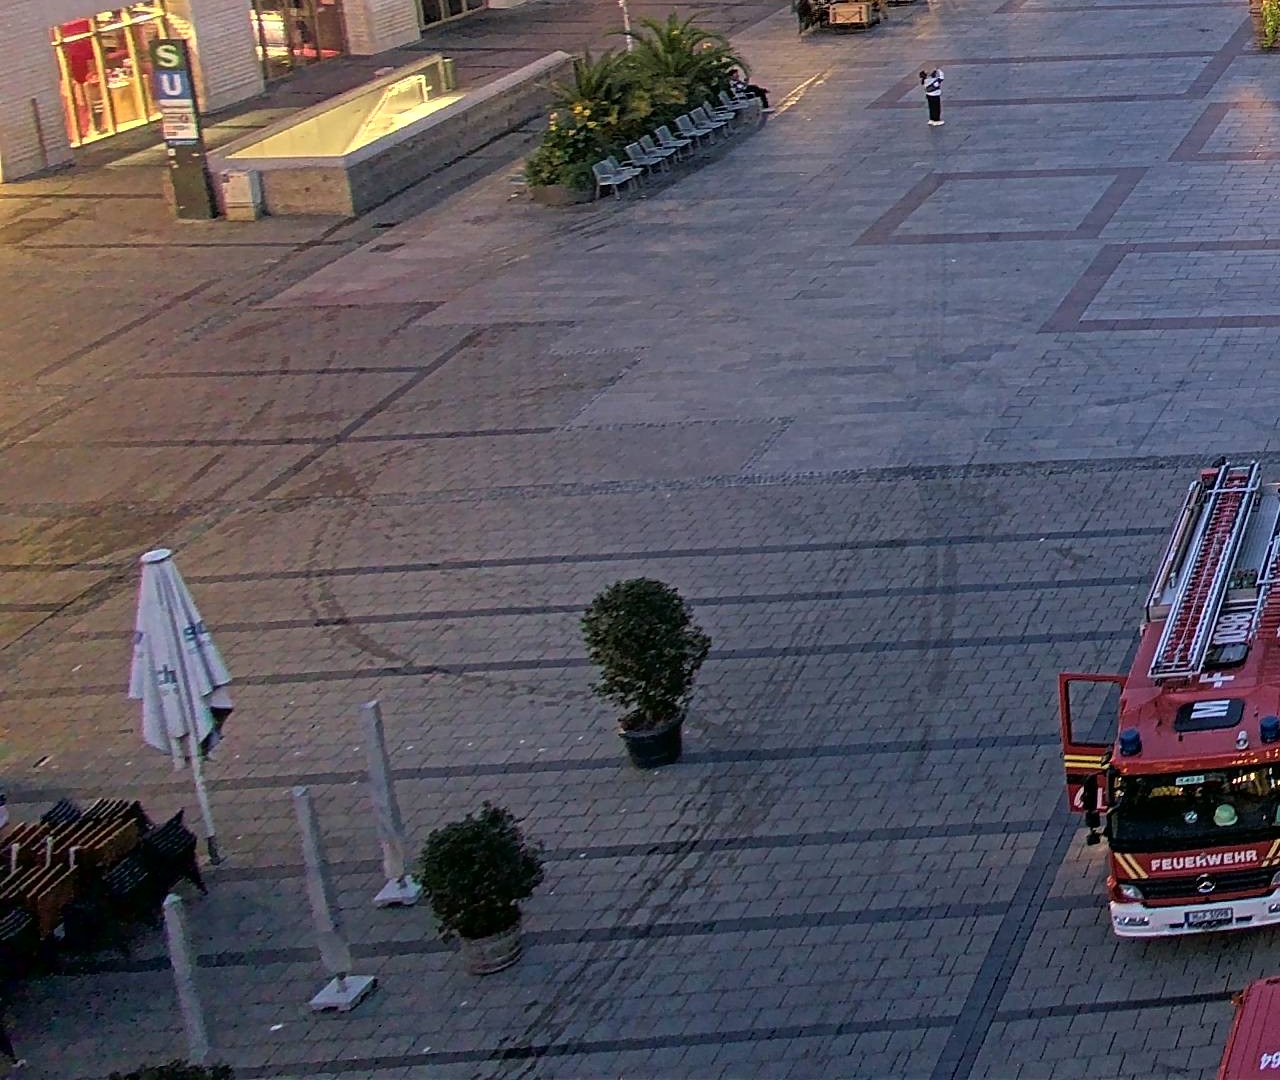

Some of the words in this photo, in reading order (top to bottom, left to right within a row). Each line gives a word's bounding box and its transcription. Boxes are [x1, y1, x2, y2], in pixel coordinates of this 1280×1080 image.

[156, 44, 180, 68] S
[161, 73, 183, 96] U
[1190, 699, 1231, 719] M
[1150, 849, 1258, 871] FEUERWEHR
